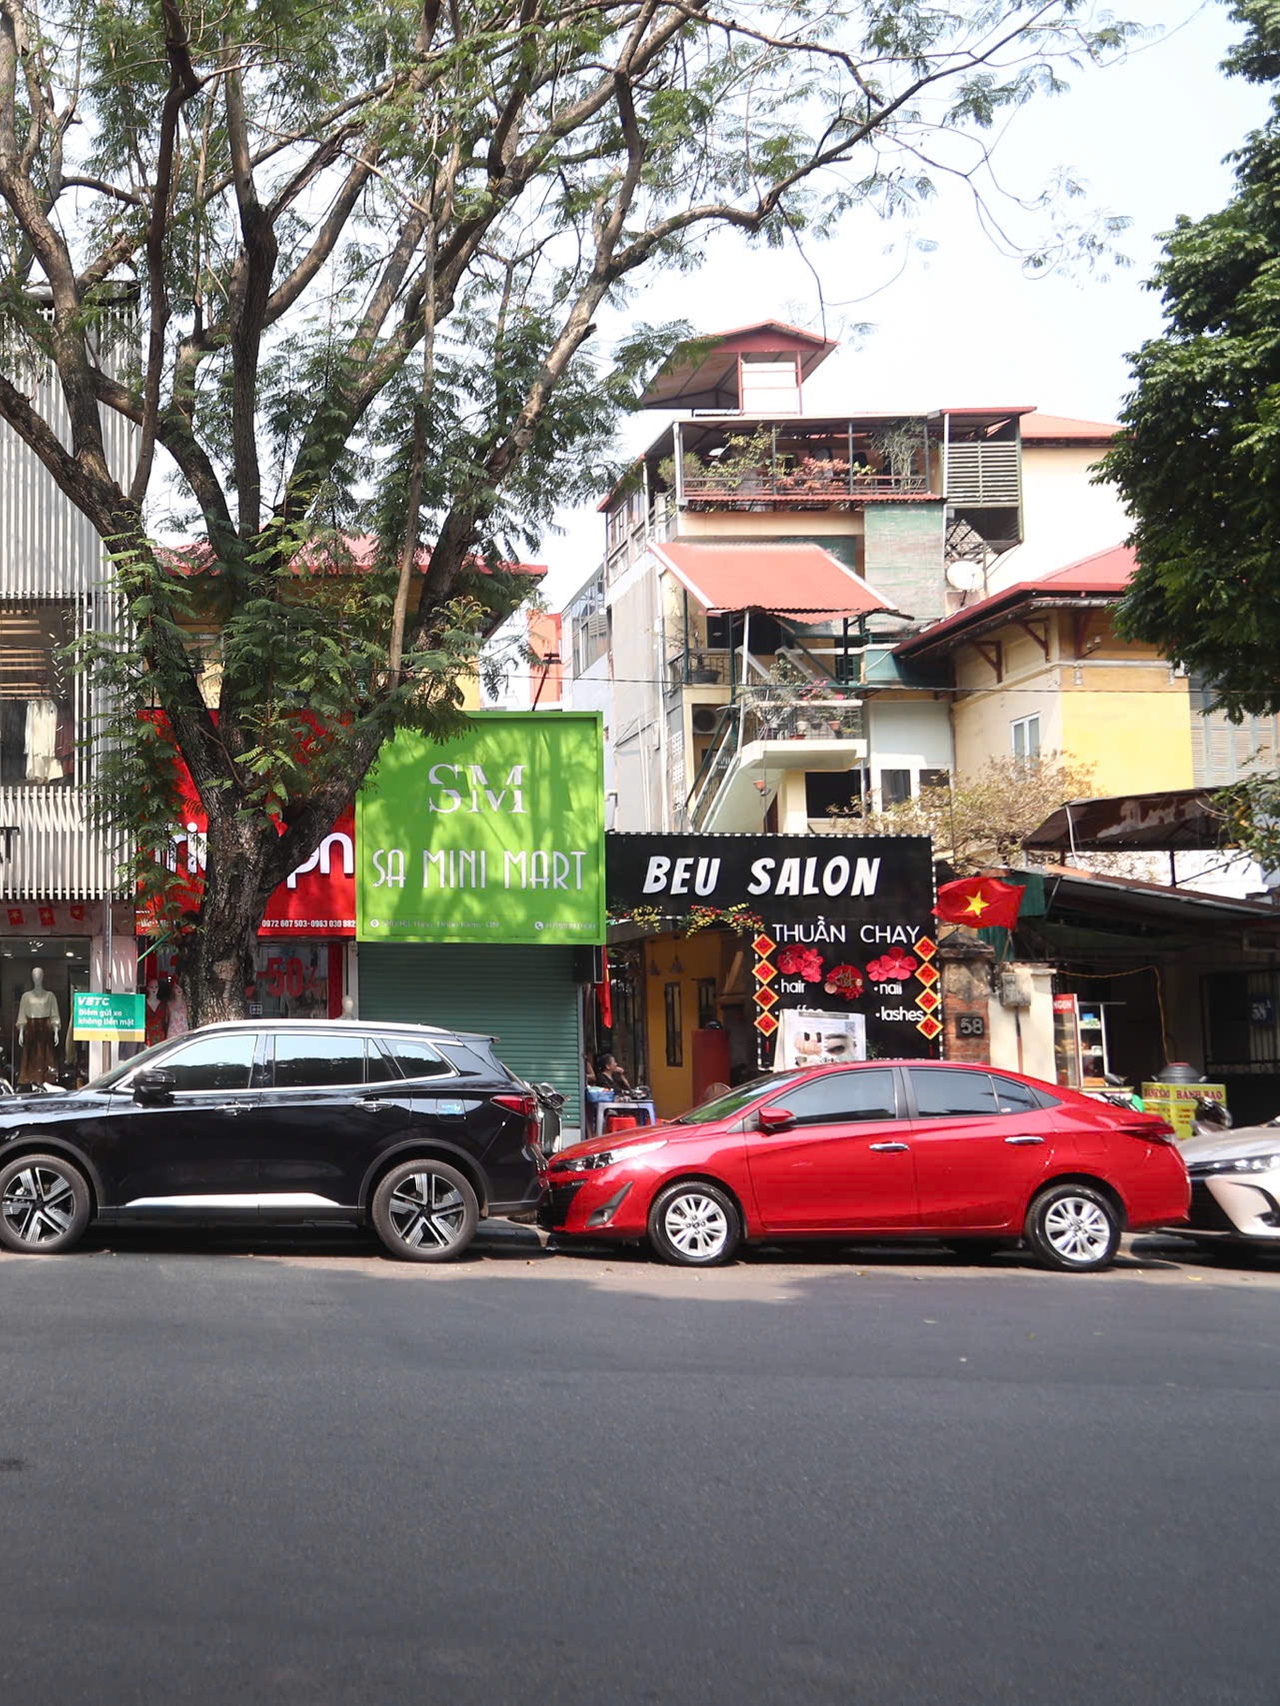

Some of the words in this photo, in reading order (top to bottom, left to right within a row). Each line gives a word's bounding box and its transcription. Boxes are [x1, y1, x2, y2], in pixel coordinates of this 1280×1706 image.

[428, 763, 528, 814] SM
[372, 849, 406, 889] SA
[423, 850, 486, 889] MINI
[504, 850, 587, 891] MART
[642, 855, 721, 897] BEU
[747, 855, 881, 898] SALON
[772, 915, 846, 943] THUẦN
[859, 924, 920, 944] CHAY
[781, 979, 806, 994] hair
[77, 996, 110, 1006] VETC
[880, 1006, 924, 1021] lashes
[960, 1017, 984, 1035] 58
